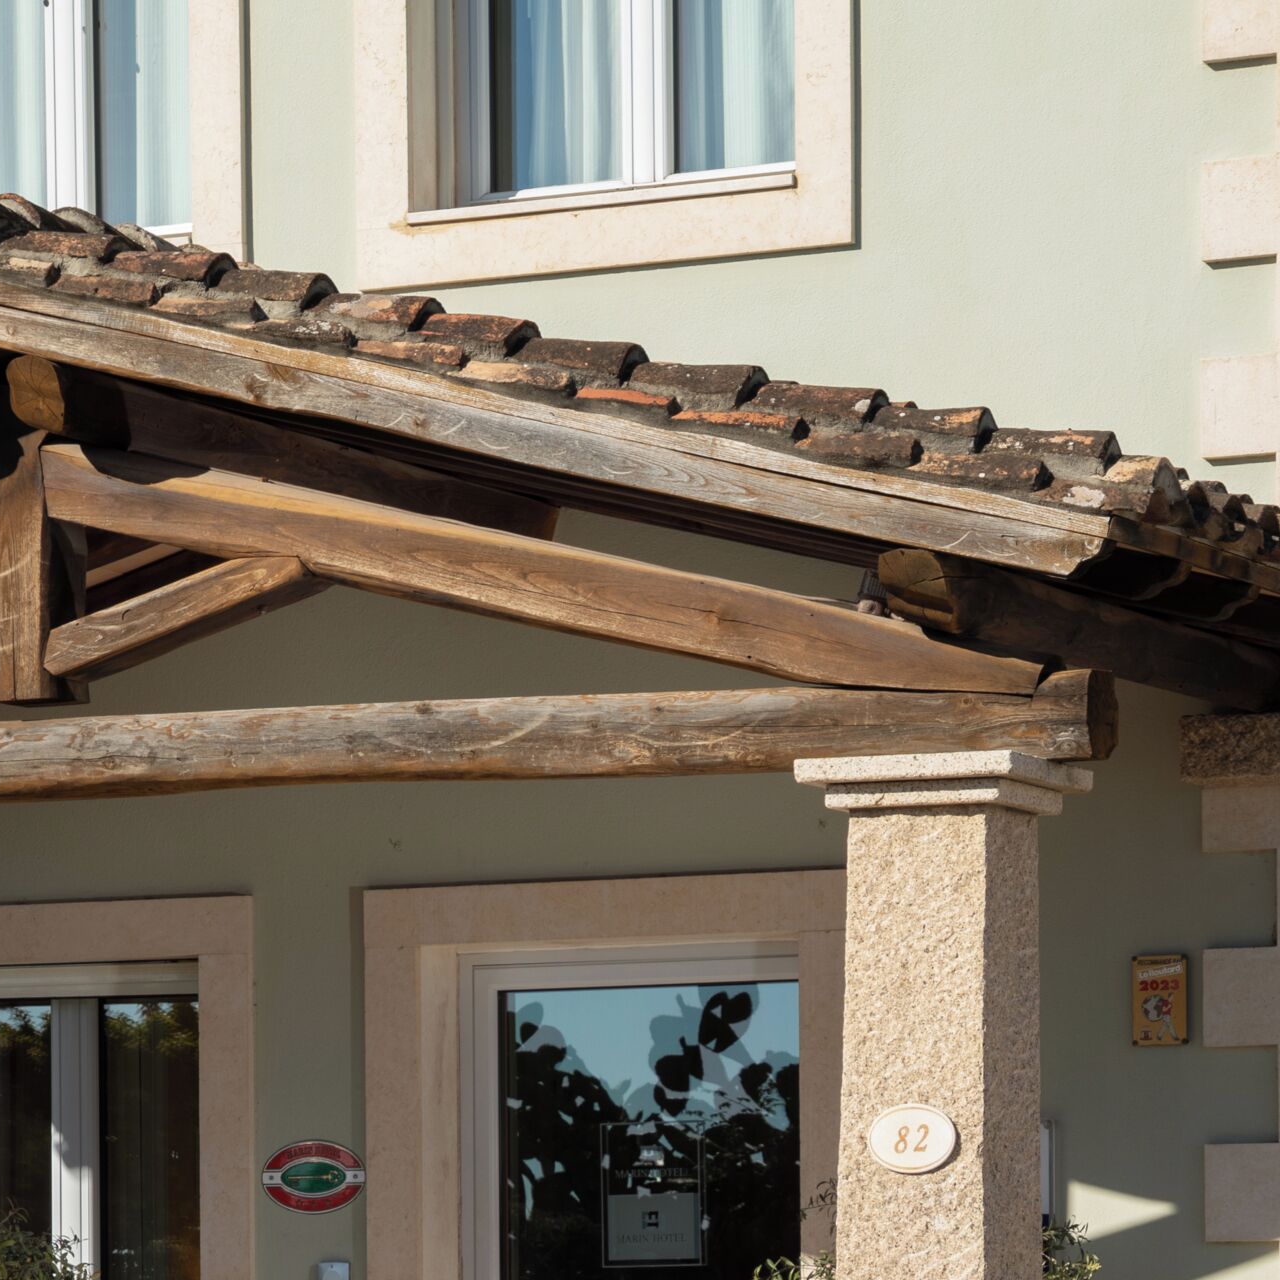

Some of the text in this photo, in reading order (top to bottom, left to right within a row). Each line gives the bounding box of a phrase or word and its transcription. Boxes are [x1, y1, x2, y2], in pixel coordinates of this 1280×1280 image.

[1138, 979, 1180, 992] 2023
[894, 1123, 929, 1154] 82
[616, 1232, 687, 1244] MARIN HOTEL
